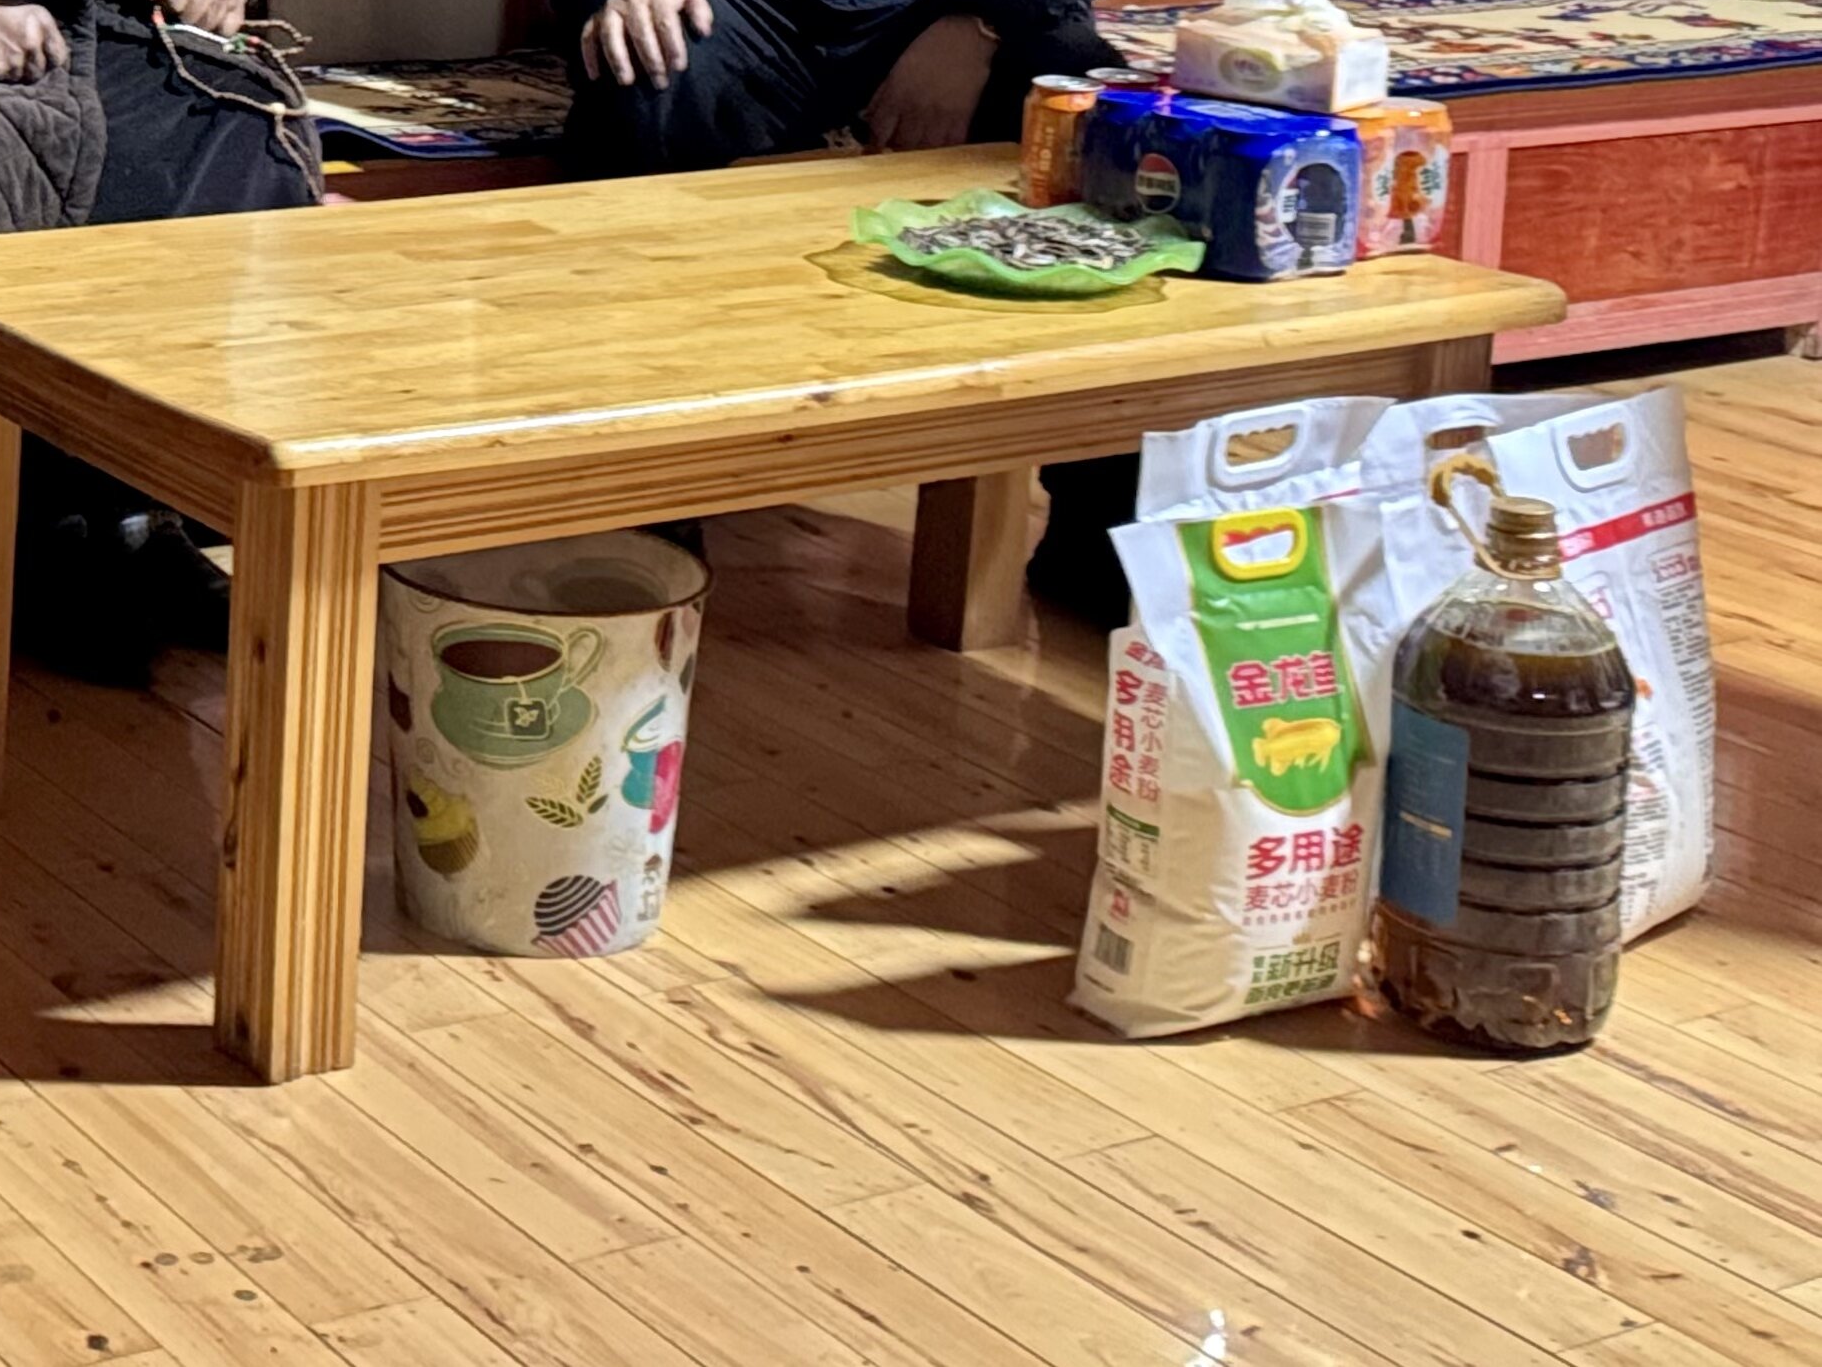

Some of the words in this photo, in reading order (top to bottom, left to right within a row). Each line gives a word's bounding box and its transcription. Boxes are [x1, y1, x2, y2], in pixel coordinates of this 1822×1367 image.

[1228, 651, 1338, 708] 金龙鱼
[1245, 823, 1364, 880] 多用途
[1243, 869, 1359, 912] 麦芯小麦粉
